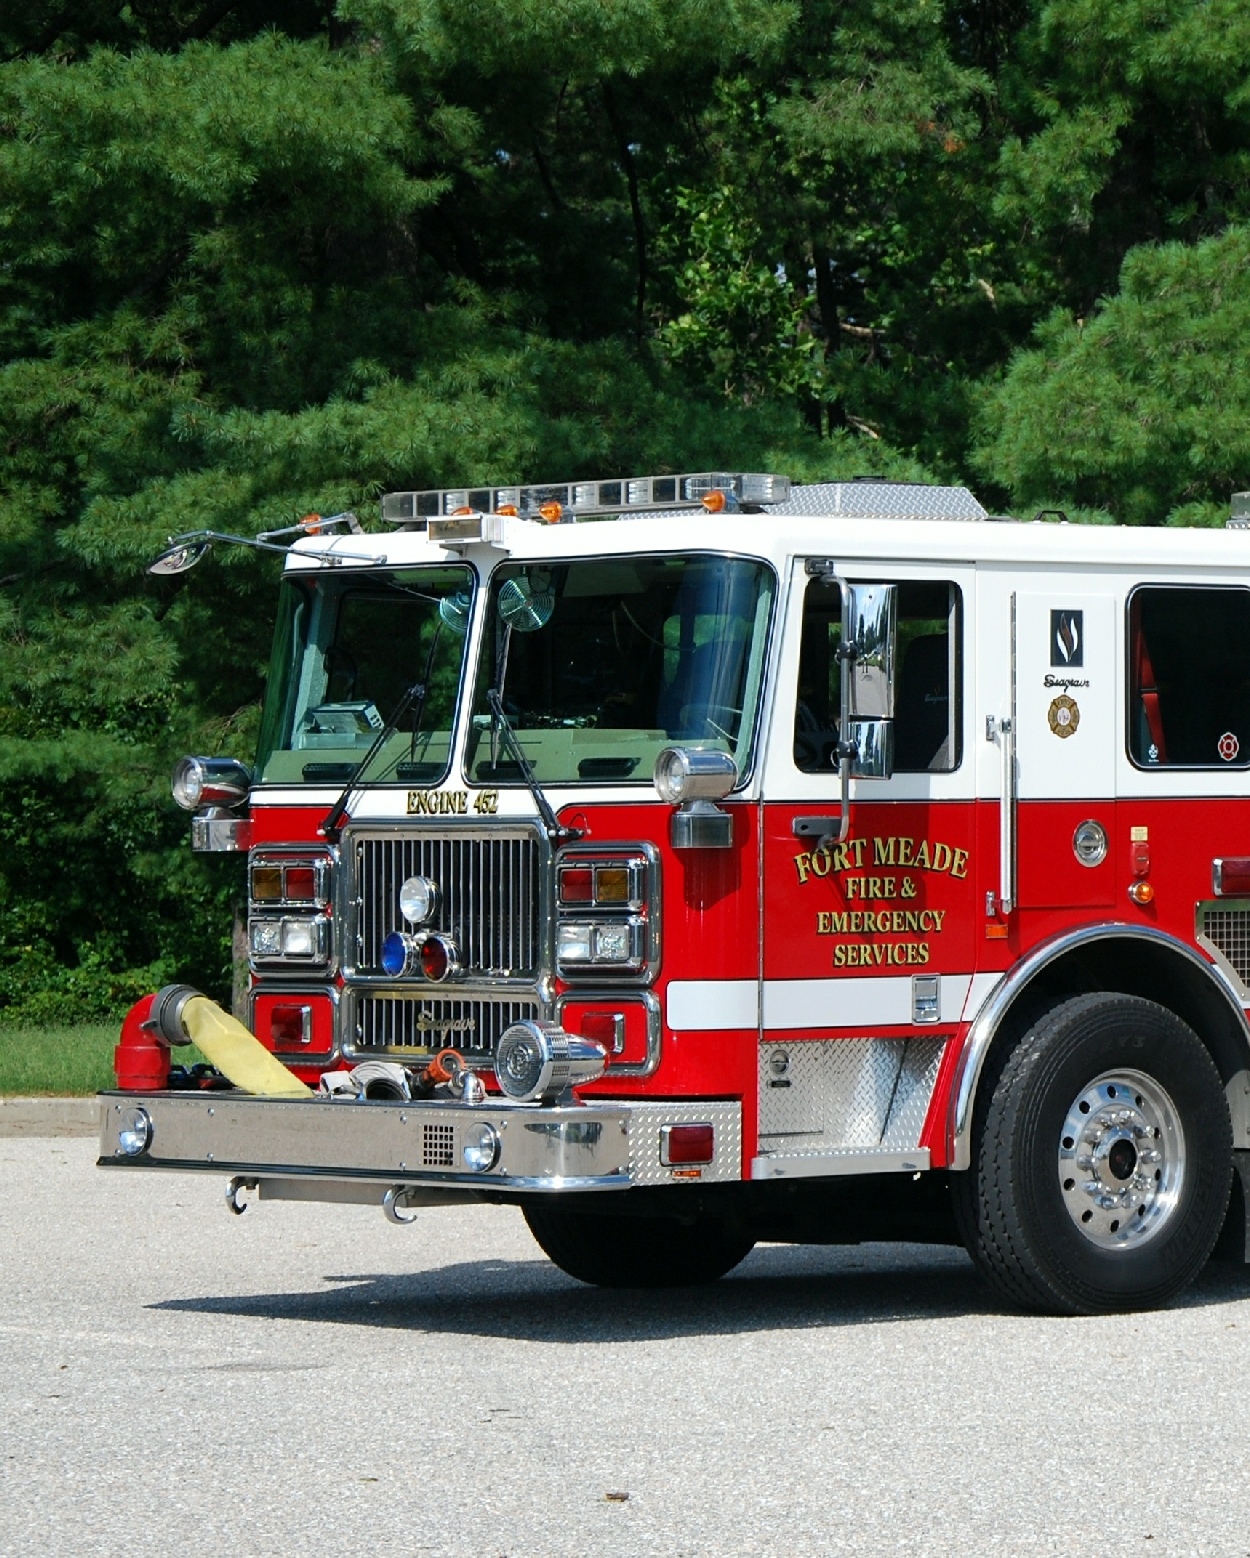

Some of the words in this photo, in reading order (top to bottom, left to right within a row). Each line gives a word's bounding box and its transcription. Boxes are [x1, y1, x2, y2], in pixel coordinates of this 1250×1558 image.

[407, 790, 469, 814] ENGINE
[474, 789, 499, 814] 452
[794, 838, 867, 883] FORT
[873, 836, 969, 879] MEADE
[845, 876, 897, 899] FIRE
[900, 876, 917, 898] &
[816, 910, 946, 934] EMERGENCY
[833, 943, 930, 967] SERVICES
